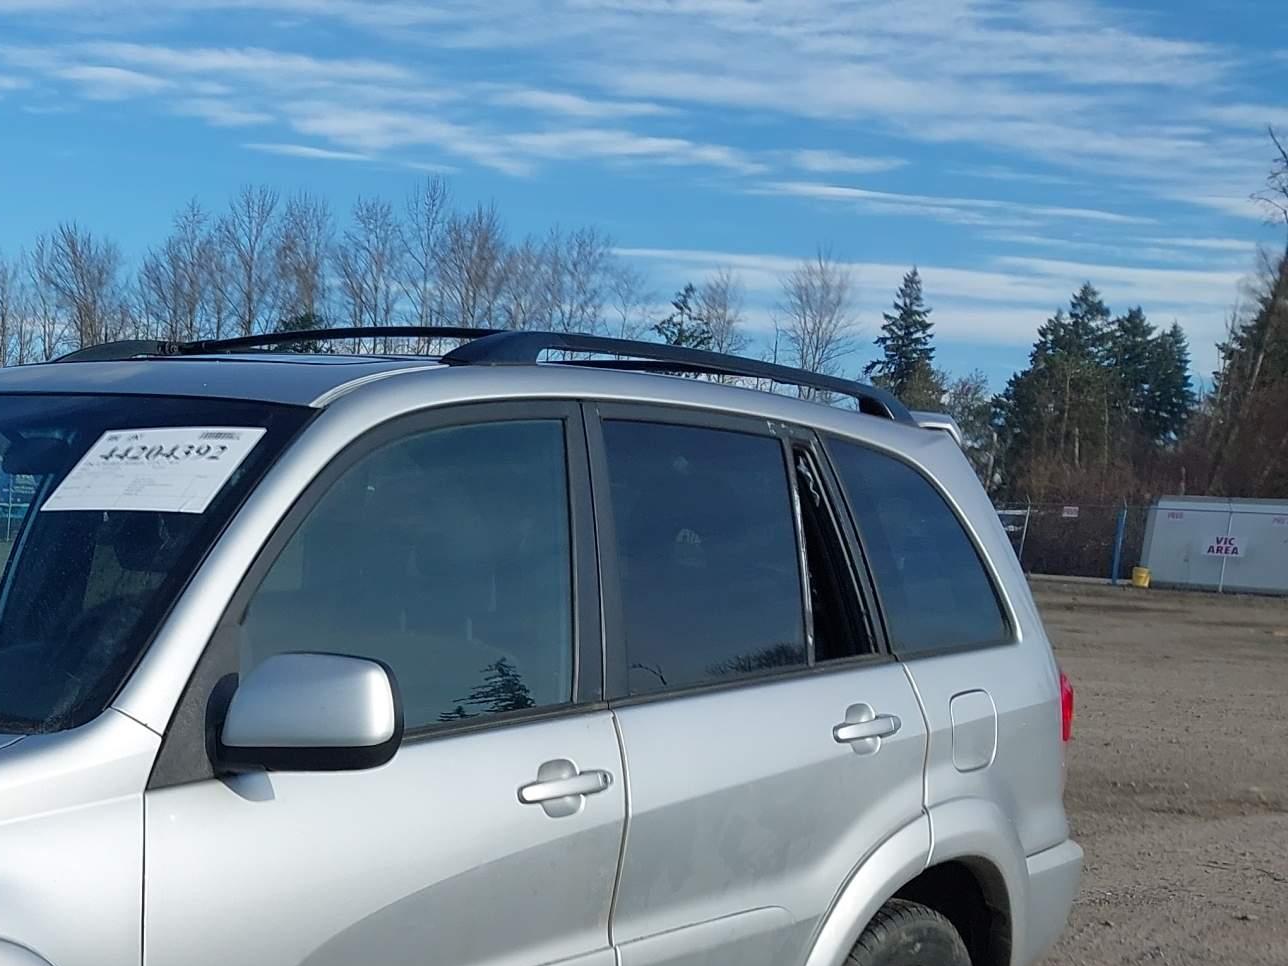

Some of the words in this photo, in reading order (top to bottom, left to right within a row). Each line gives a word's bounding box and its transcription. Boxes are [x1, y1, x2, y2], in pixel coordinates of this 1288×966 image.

[100, 445, 228, 460] 44204392
[1216, 536, 1235, 545] VIC
[1207, 545, 1239, 554] AREA
